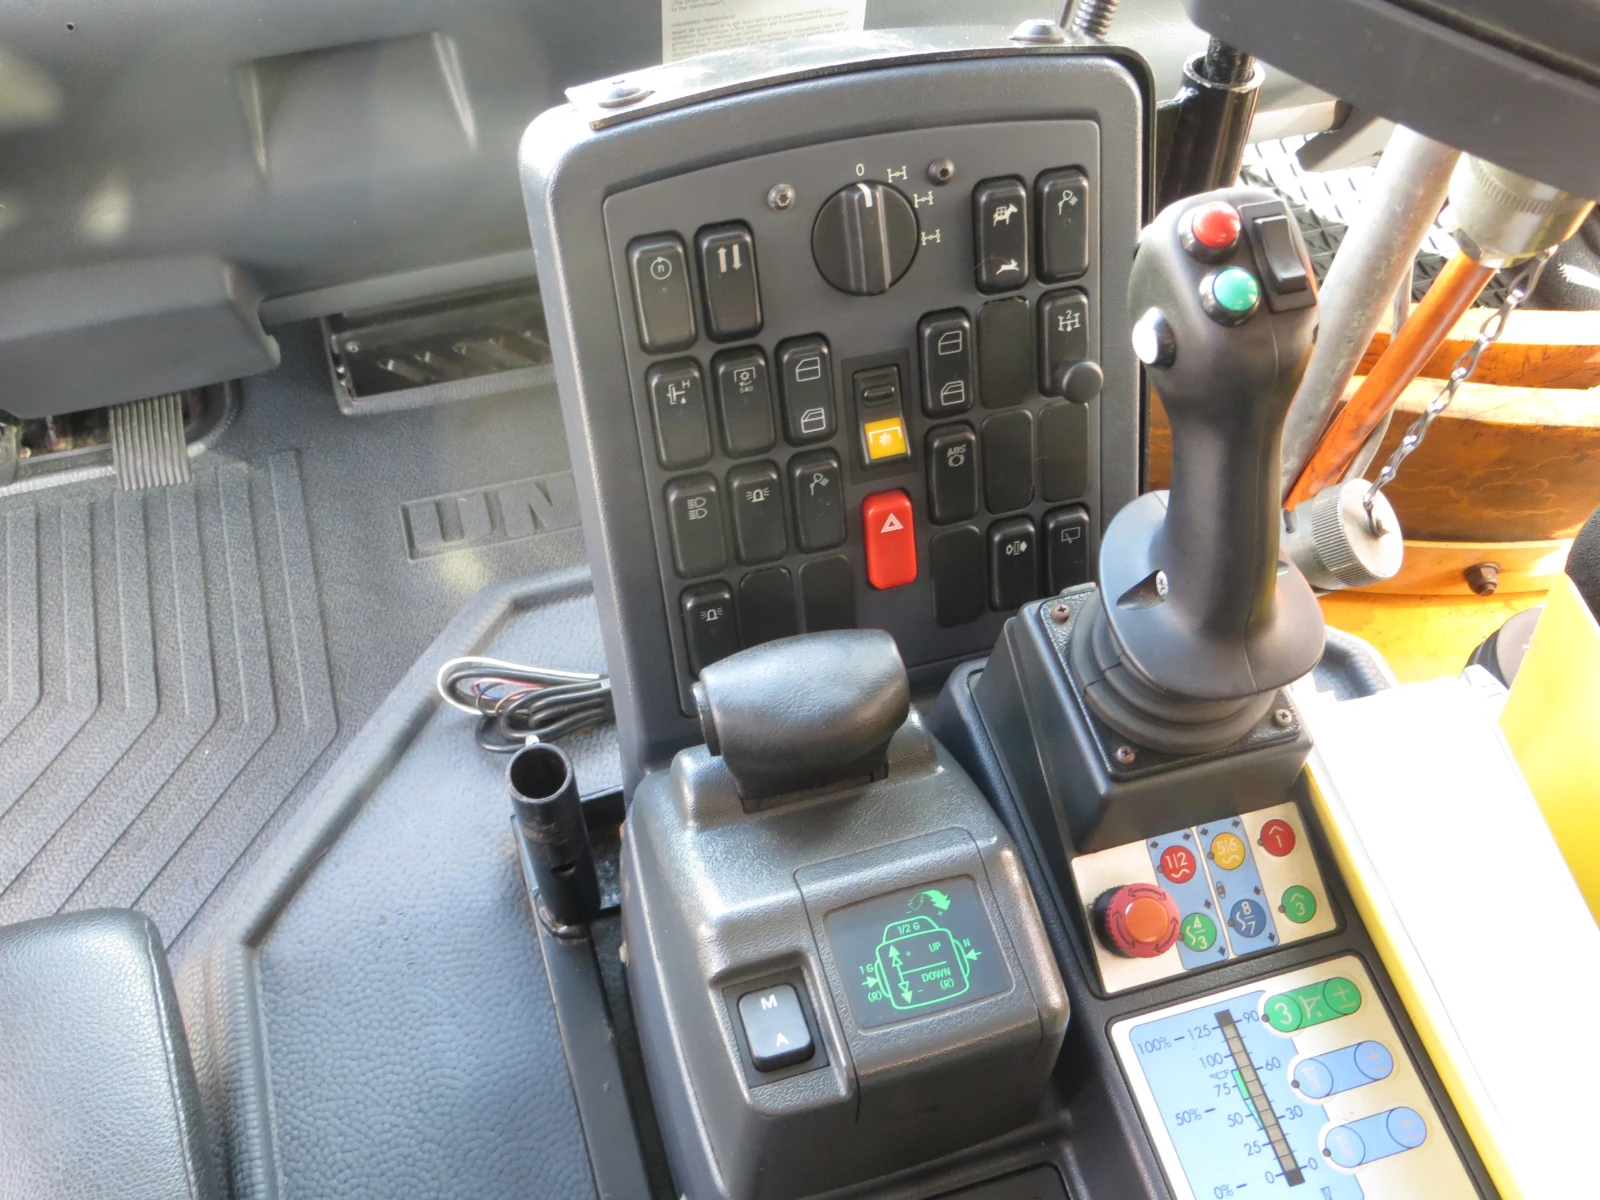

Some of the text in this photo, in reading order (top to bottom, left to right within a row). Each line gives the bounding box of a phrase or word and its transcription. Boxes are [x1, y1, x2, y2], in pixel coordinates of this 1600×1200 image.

[855, 164, 865, 177] 0
[1065, 309, 1072, 319] 2
[681, 379, 691, 389] H
[946, 443, 967, 457] ABS
[1274, 835, 1283, 849] 1
[1295, 903, 1306, 917] 3
[912, 921, 921, 931] G
[928, 941, 941, 952] UP
[962, 938, 971, 948] N
[866, 963, 874, 973] G
[921, 967, 952, 983] DOWN
[939, 978, 955, 990] (R)
[760, 994, 777, 1010] M
[867, 990, 882, 1003] (R)
[1242, 1010, 1260, 1025] 90
[1273, 1003, 1293, 1025] 3
[775, 1033, 789, 1048] A
[1187, 1024, 1212, 1042] 125
[1137, 1036, 1172, 1056] 100%
[1200, 1052, 1223, 1070] 100
[1265, 1057, 1282, 1072] 60
[1213, 1082, 1231, 1098] 75
[1175, 1108, 1202, 1127] 50%
[1227, 1112, 1244, 1128] 50
[1287, 1105, 1304, 1121] 30
[1244, 1140, 1262, 1157] 25
[1307, 1156, 1319, 1171] 0
[1264, 1171, 1275, 1185] 0
[1213, 1182, 1234, 1200] 0%
